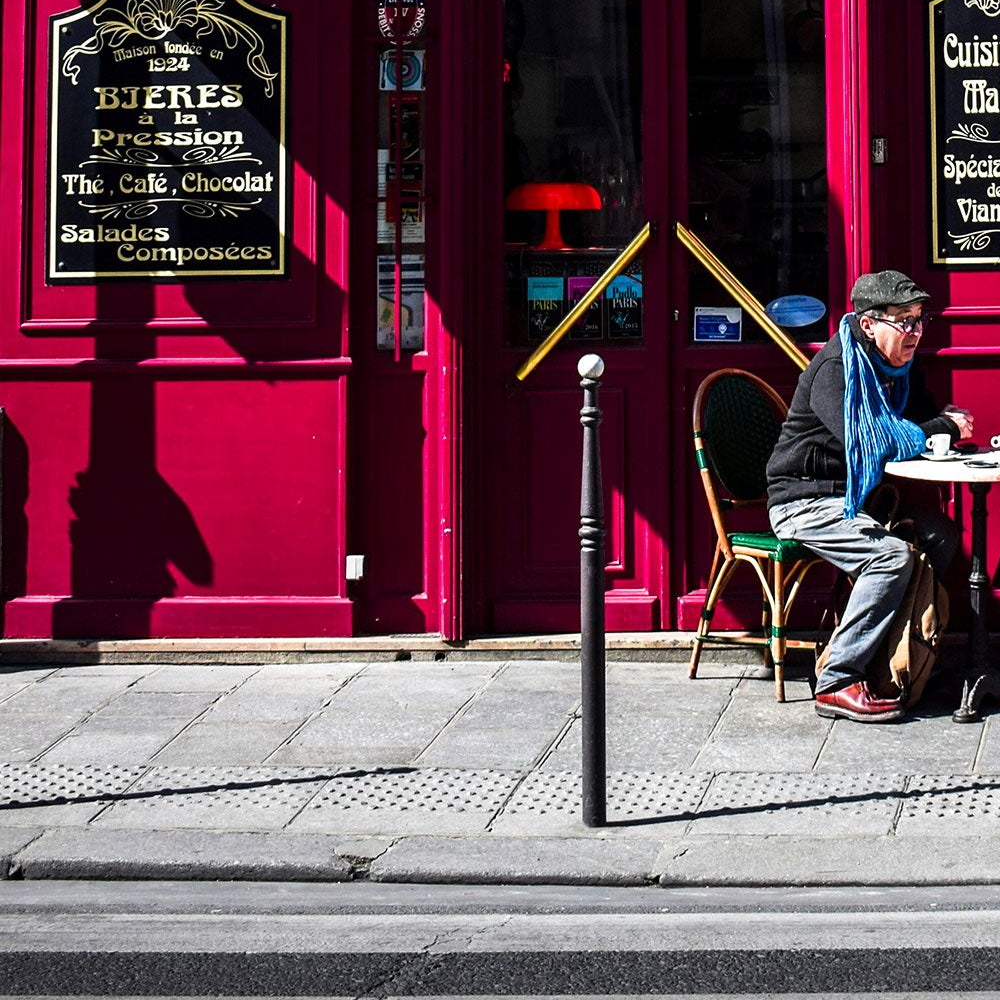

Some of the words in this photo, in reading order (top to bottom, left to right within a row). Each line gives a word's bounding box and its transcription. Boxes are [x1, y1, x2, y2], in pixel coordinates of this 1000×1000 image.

[113, 45, 156, 62] Maison
[164, 41, 203, 54] fondée
[210, 49, 224, 61] en
[148, 57, 190, 72] 1924
[94, 84, 243, 110] BIERES
[138, 111, 154, 125] à
[173, 111, 198, 125] la
[91, 128, 244, 147] Pression
[181, 171, 274, 193] Chocolat
[60, 224, 170, 243] Salades
[117, 242, 273, 266] Composées
[533, 299, 558, 310] PARIS
[612, 298, 638, 309] PARIS
